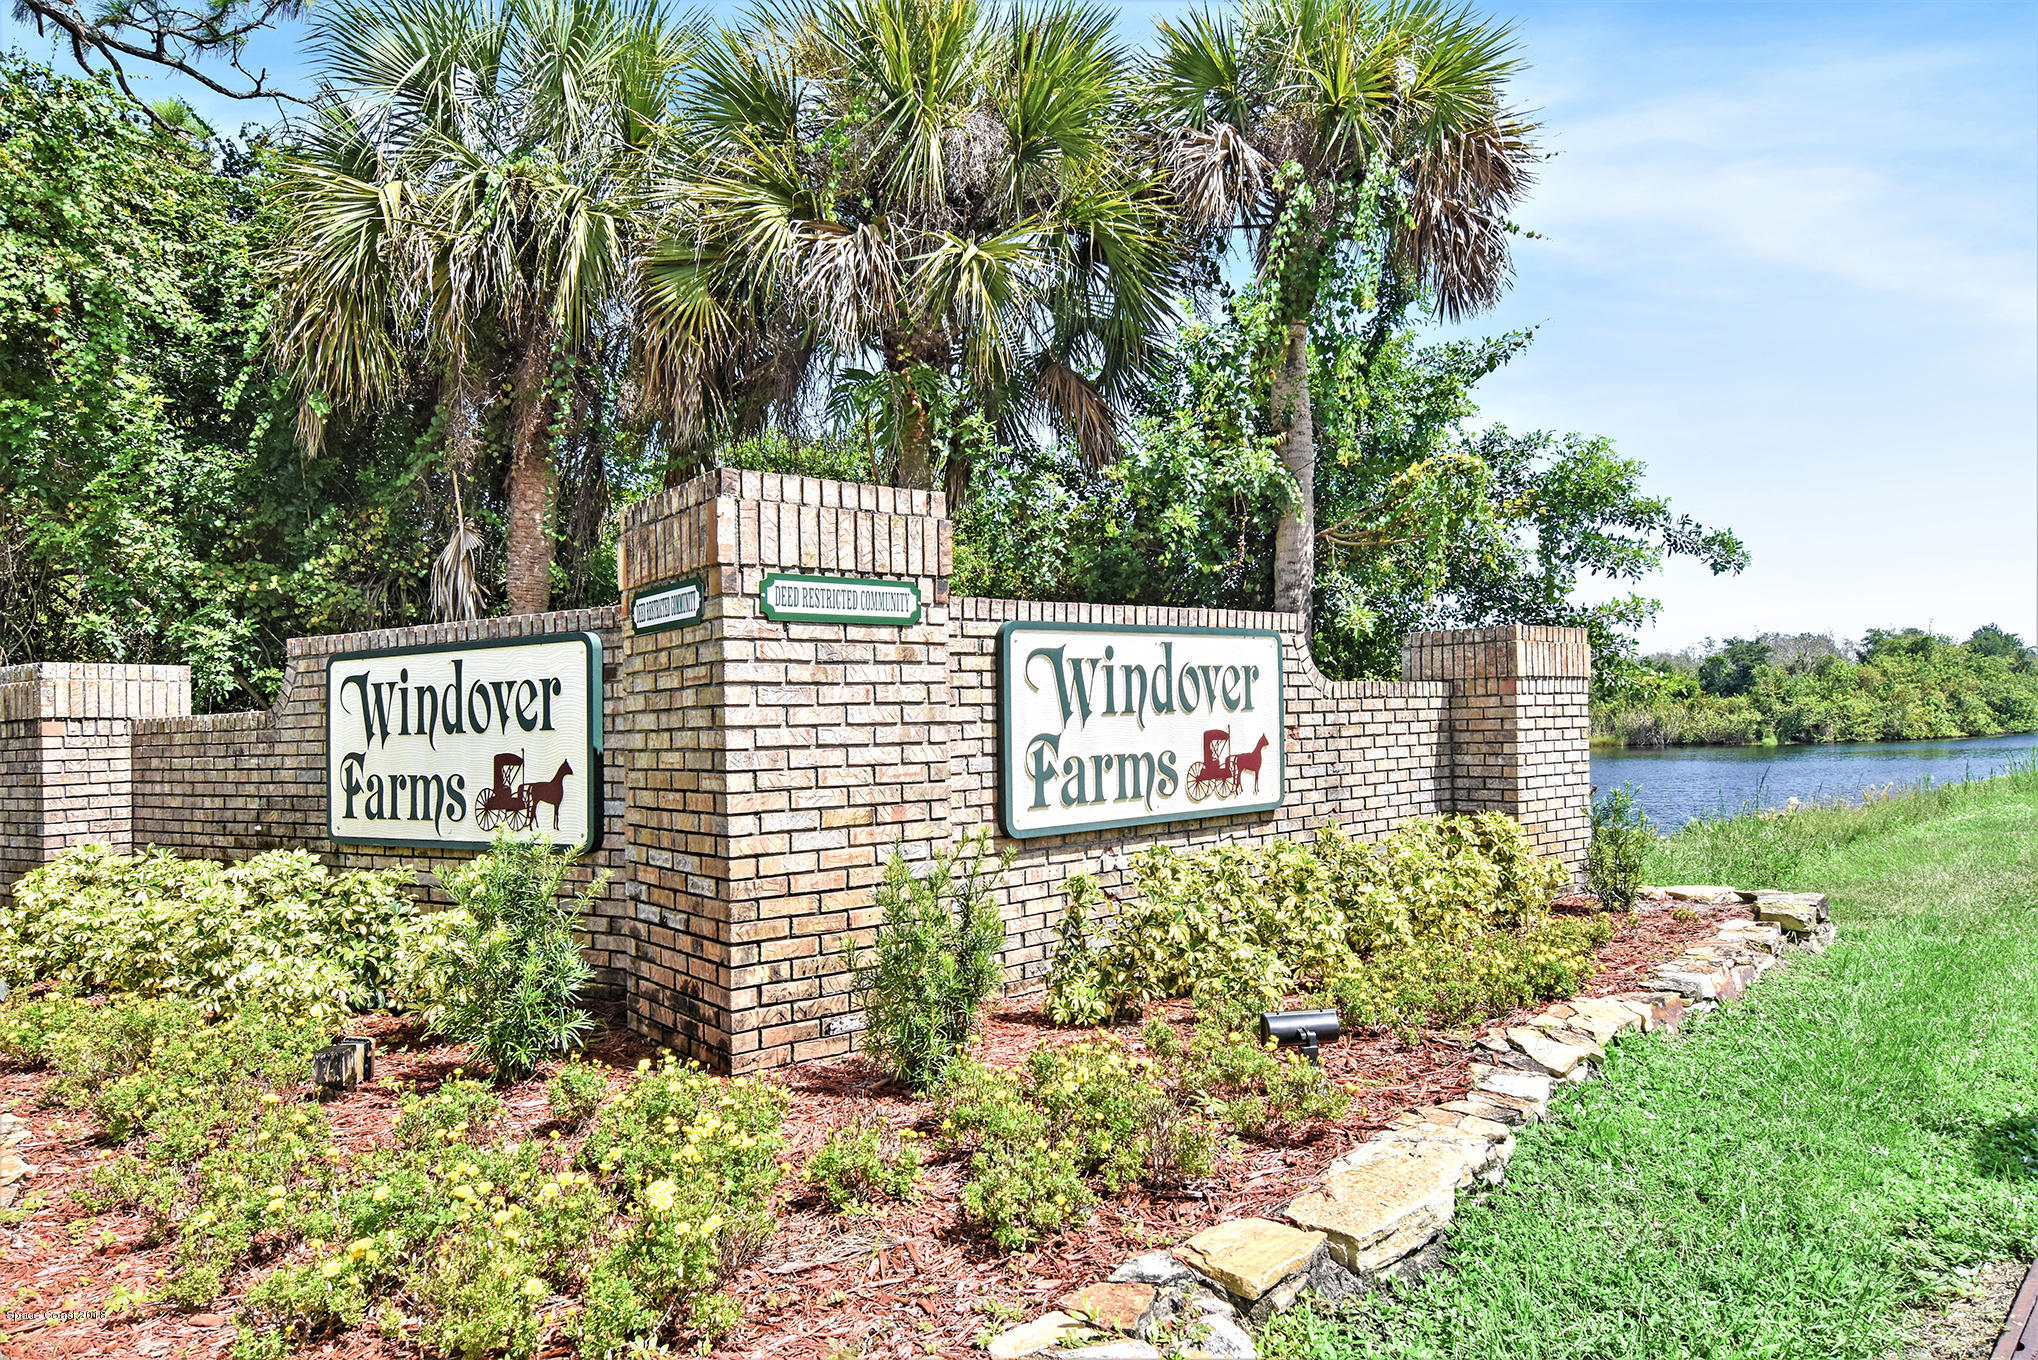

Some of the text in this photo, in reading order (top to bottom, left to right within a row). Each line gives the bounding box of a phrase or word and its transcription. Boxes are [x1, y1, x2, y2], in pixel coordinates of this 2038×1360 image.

[775, 585, 910, 613] DEED RESTRICTED COMMUNITY
[340, 659, 562, 751] Windover
[1024, 641, 1260, 730] Windover
[340, 752, 467, 837] Farms
[1024, 732, 1179, 813] Farms
